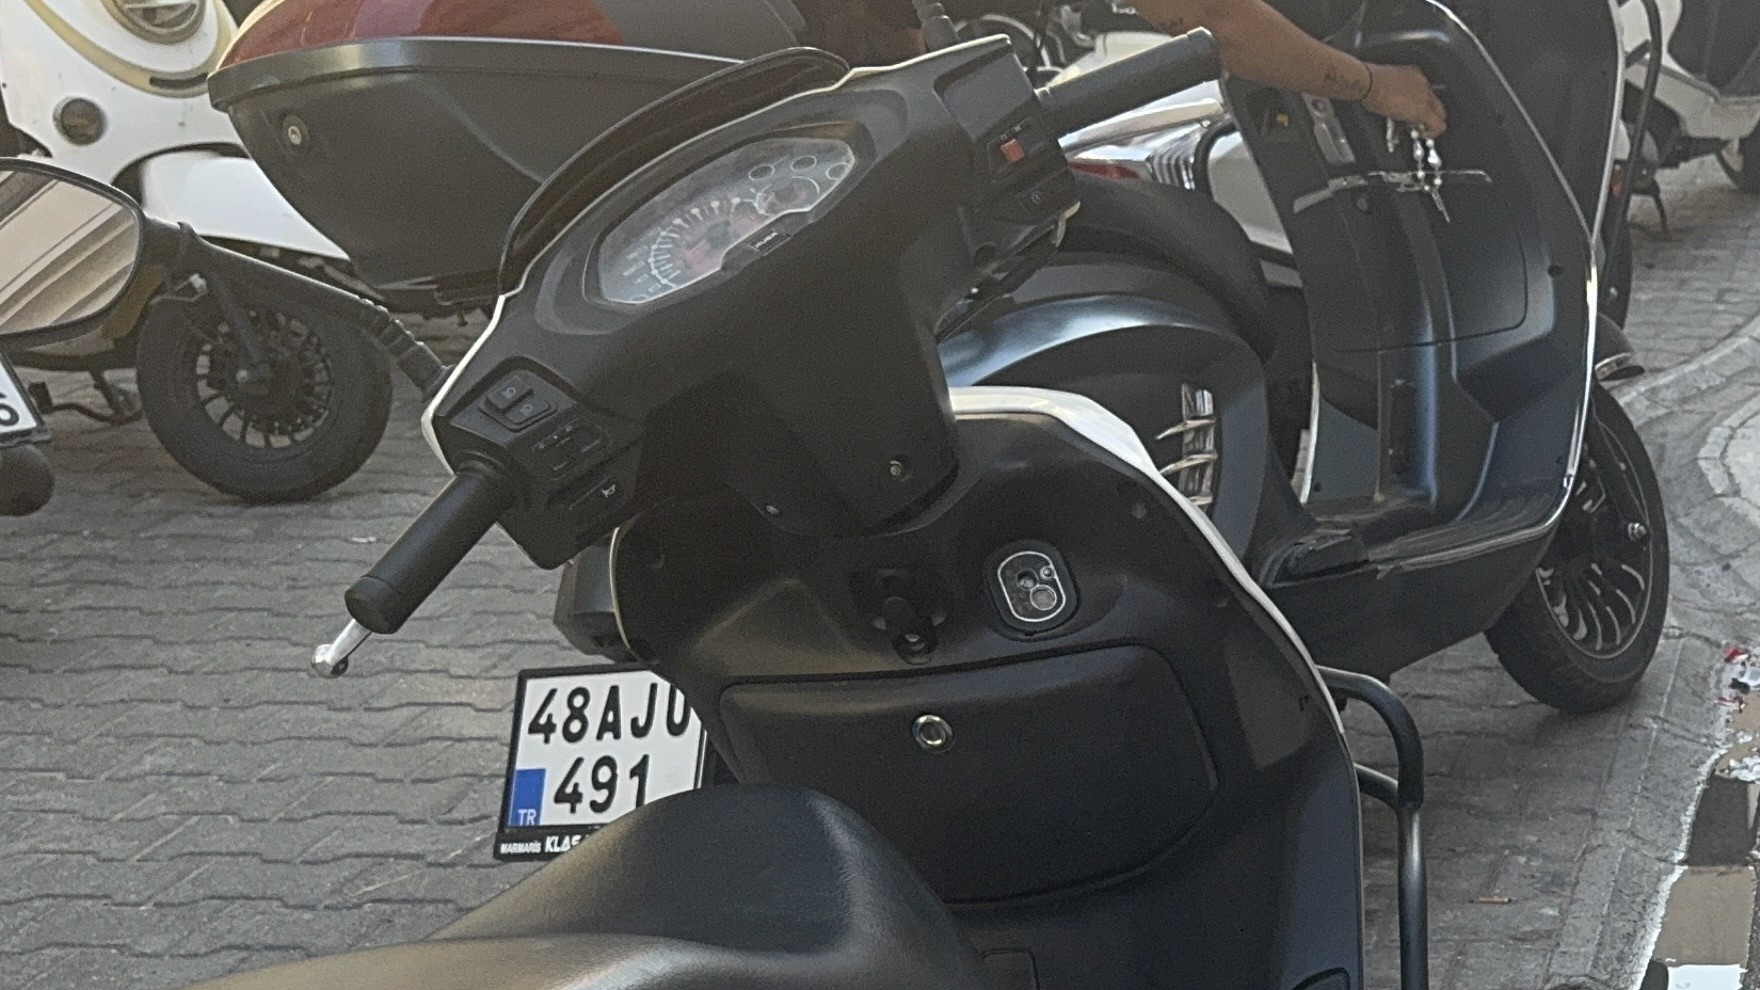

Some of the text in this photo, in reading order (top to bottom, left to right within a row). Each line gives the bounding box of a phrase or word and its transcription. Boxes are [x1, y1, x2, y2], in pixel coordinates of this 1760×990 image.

[527, 683, 690, 744] 48AJU
[553, 753, 650, 815] 491
[517, 809, 537, 827] TR
